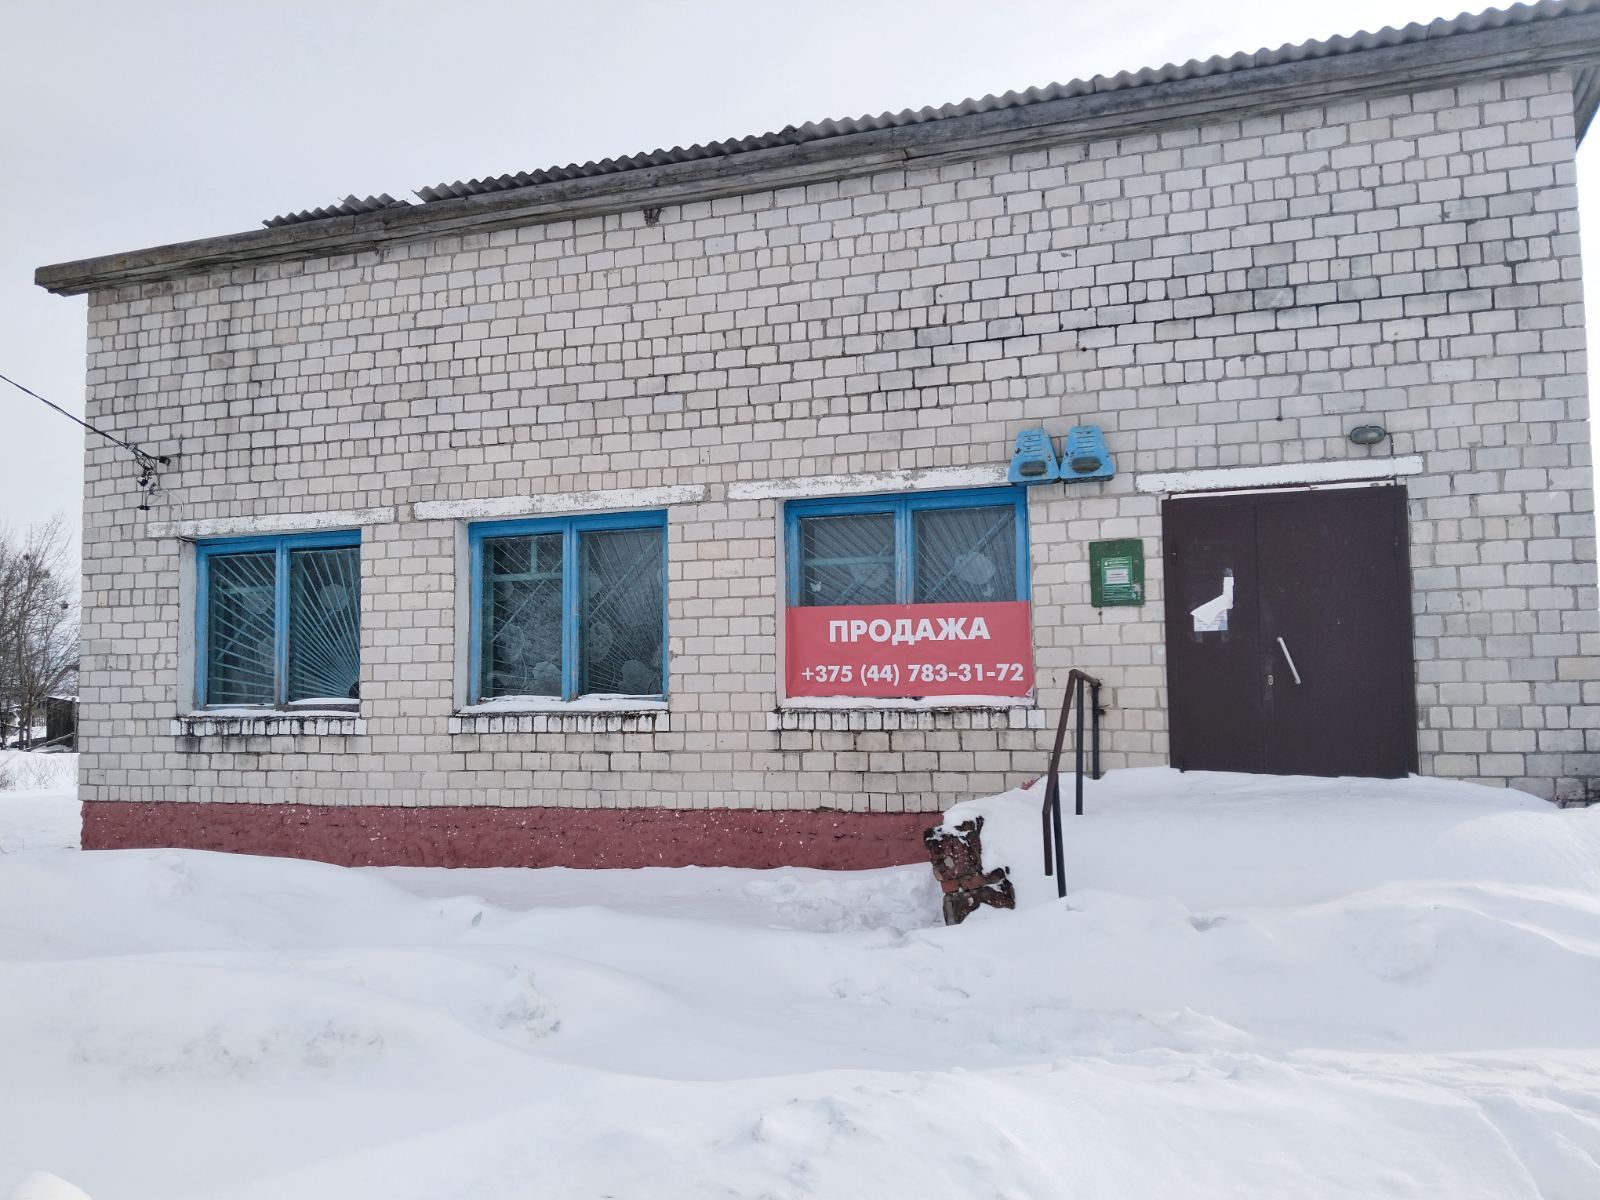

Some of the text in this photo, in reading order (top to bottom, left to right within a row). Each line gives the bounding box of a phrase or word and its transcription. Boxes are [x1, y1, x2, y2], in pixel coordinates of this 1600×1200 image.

[829, 617, 990, 645] ПРОДАЖА
[801, 663, 1024, 686] +375 (44) 783-31-72
